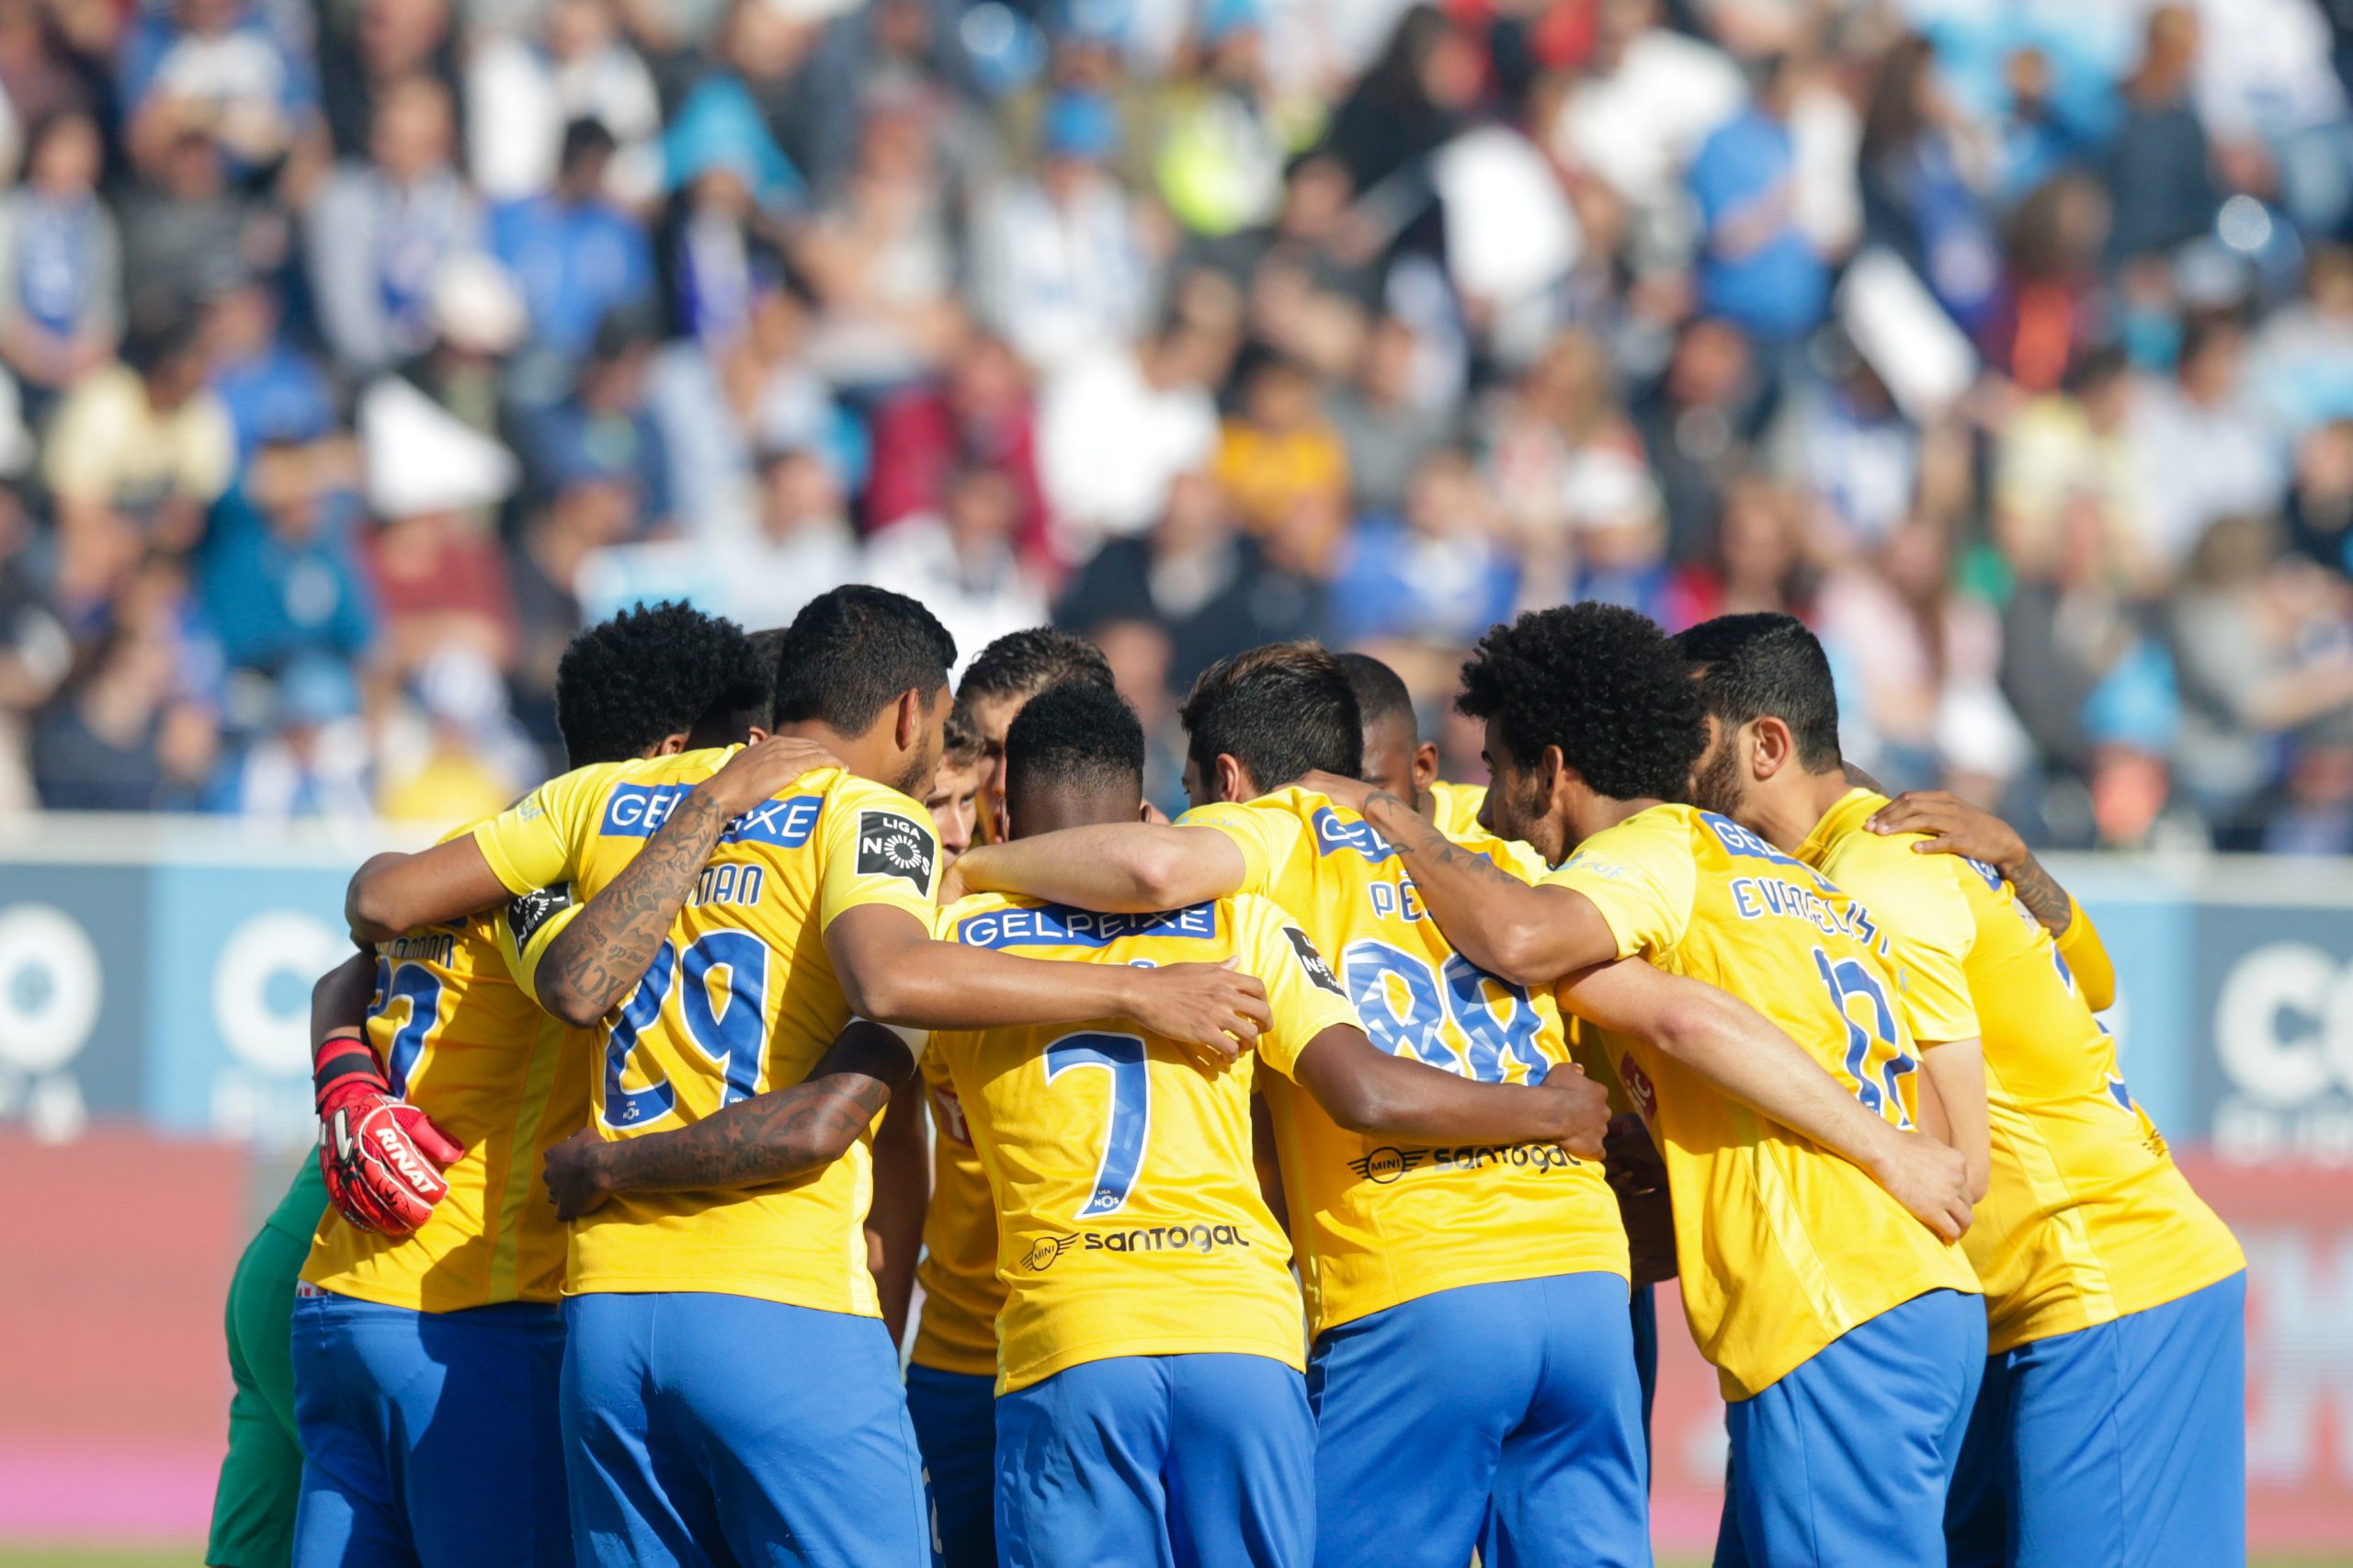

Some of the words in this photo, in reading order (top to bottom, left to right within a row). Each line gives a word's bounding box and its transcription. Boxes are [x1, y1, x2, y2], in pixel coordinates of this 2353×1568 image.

[883, 817, 920, 840] LIGA
[862, 835, 930, 876] NOS
[965, 908, 1208, 947] GELPEIXE
[599, 928, 770, 1130] 29
[1343, 938, 1552, 1086] 88
[1043, 1030, 1151, 1220] 7
[376, 1128, 439, 1193] RINAT
[1371, 1158, 1401, 1172] MINI
[1094, 1195, 1120, 1208] NOS
[1033, 1244, 1055, 1262] MINI
